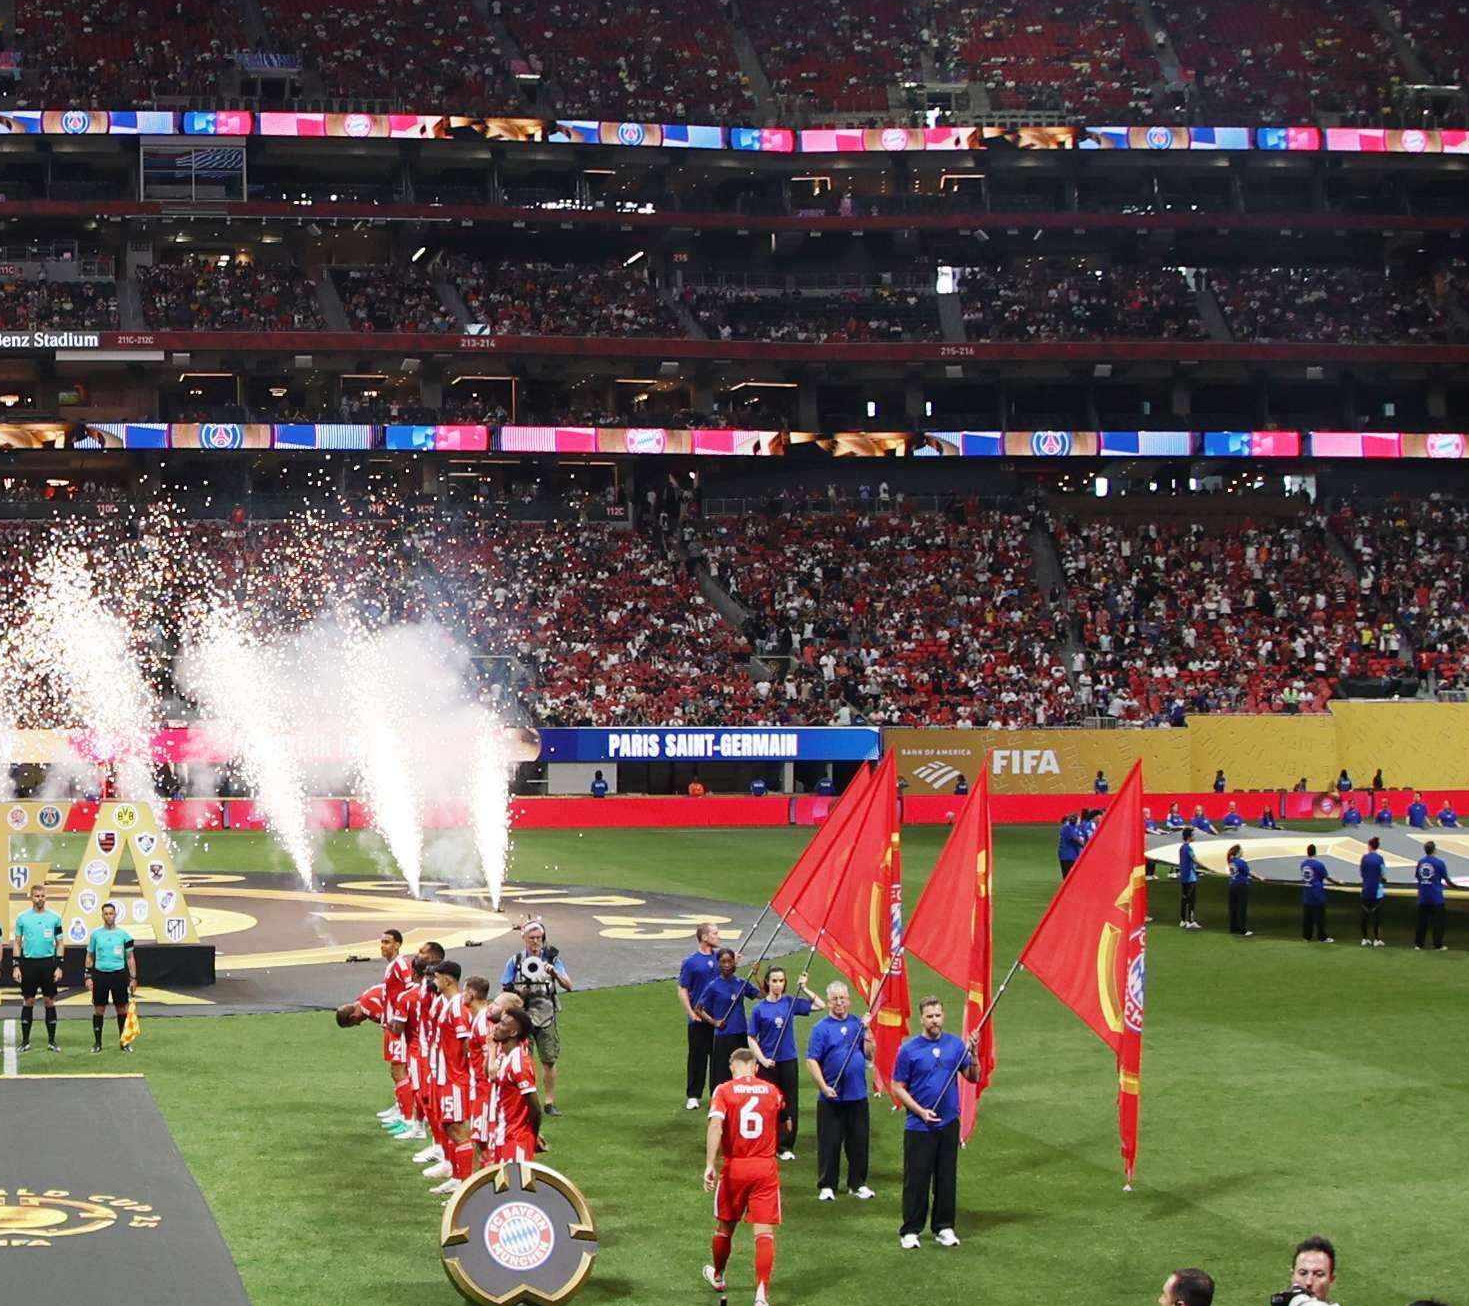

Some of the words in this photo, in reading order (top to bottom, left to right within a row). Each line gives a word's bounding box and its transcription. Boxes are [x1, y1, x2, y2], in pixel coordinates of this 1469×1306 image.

[33, 332, 99, 347] Stadium
[608, 733, 660, 758] PARIS
[664, 733, 798, 757] SAINT-GERMAIN
[992, 749, 1060, 774] FIFA
[739, 1096, 764, 1140] 6
[489, 1216, 504, 1232] FC
[505, 1205, 549, 1232] BAYERN
